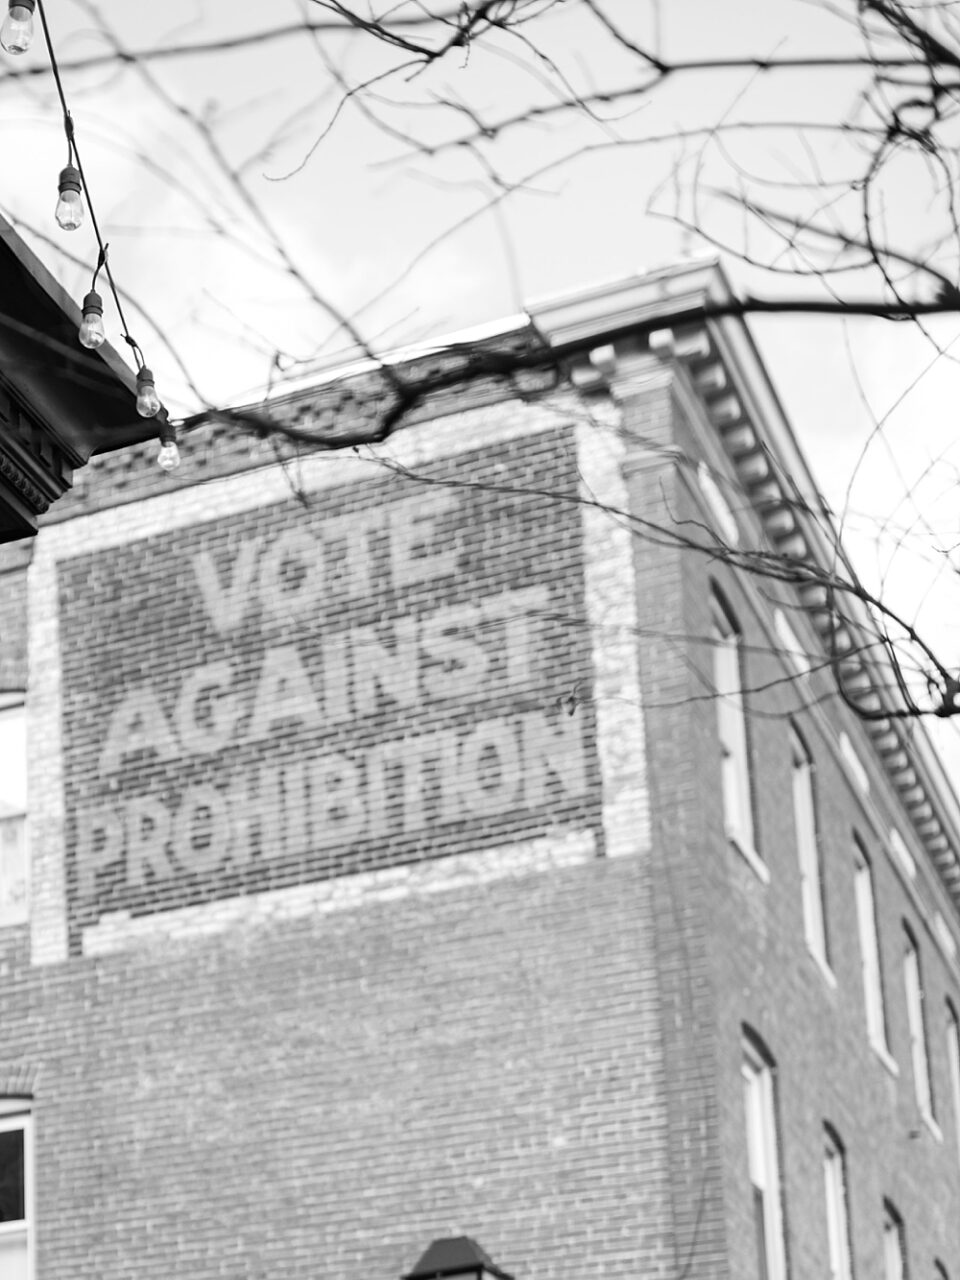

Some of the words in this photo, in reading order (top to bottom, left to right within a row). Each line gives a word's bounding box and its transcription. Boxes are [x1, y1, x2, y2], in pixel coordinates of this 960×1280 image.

[192, 487, 462, 637] VOTE
[101, 583, 550, 772] AGAINST
[75, 704, 591, 896] PROHIBITION
